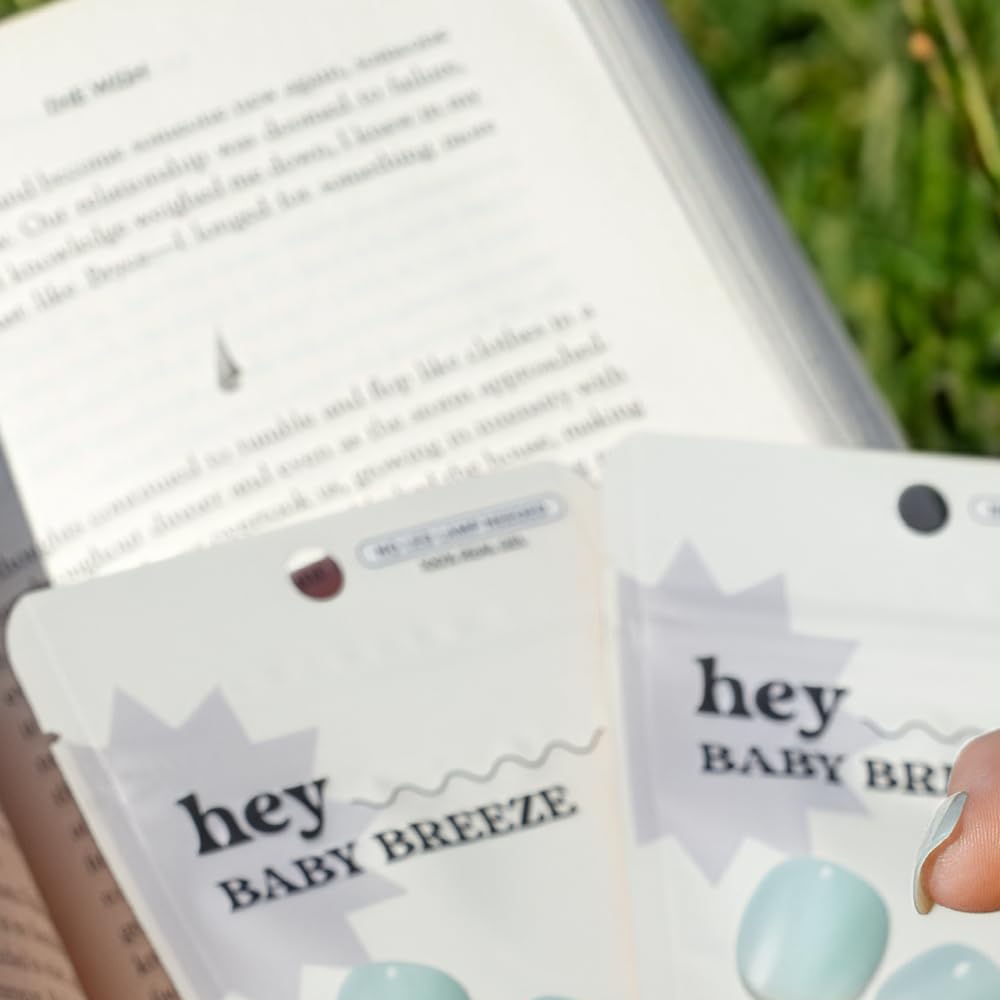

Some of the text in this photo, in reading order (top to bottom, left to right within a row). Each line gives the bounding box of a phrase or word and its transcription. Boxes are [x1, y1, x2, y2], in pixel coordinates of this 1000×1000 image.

[696, 656, 848, 739] hey
[698, 742, 846, 785] BABY
[176, 777, 330, 857] hey
[217, 785, 579, 912] BABY BREEZE
